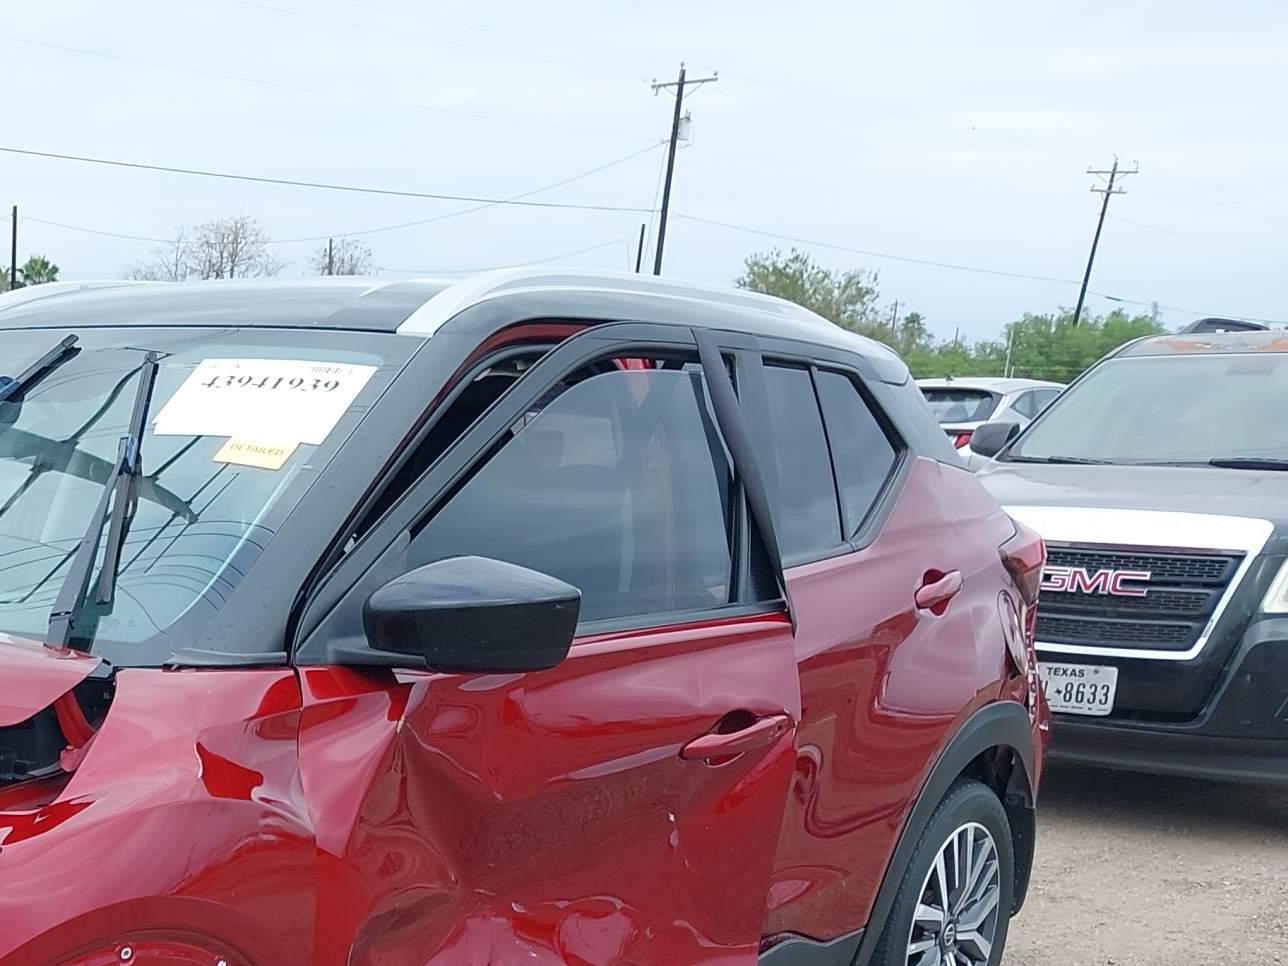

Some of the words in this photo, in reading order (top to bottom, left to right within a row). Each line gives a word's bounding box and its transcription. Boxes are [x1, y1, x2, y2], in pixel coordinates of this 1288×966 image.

[201, 375, 340, 392] 43941939
[1040, 566, 1151, 597] GMC
[1046, 666, 1086, 678] TEXAS
